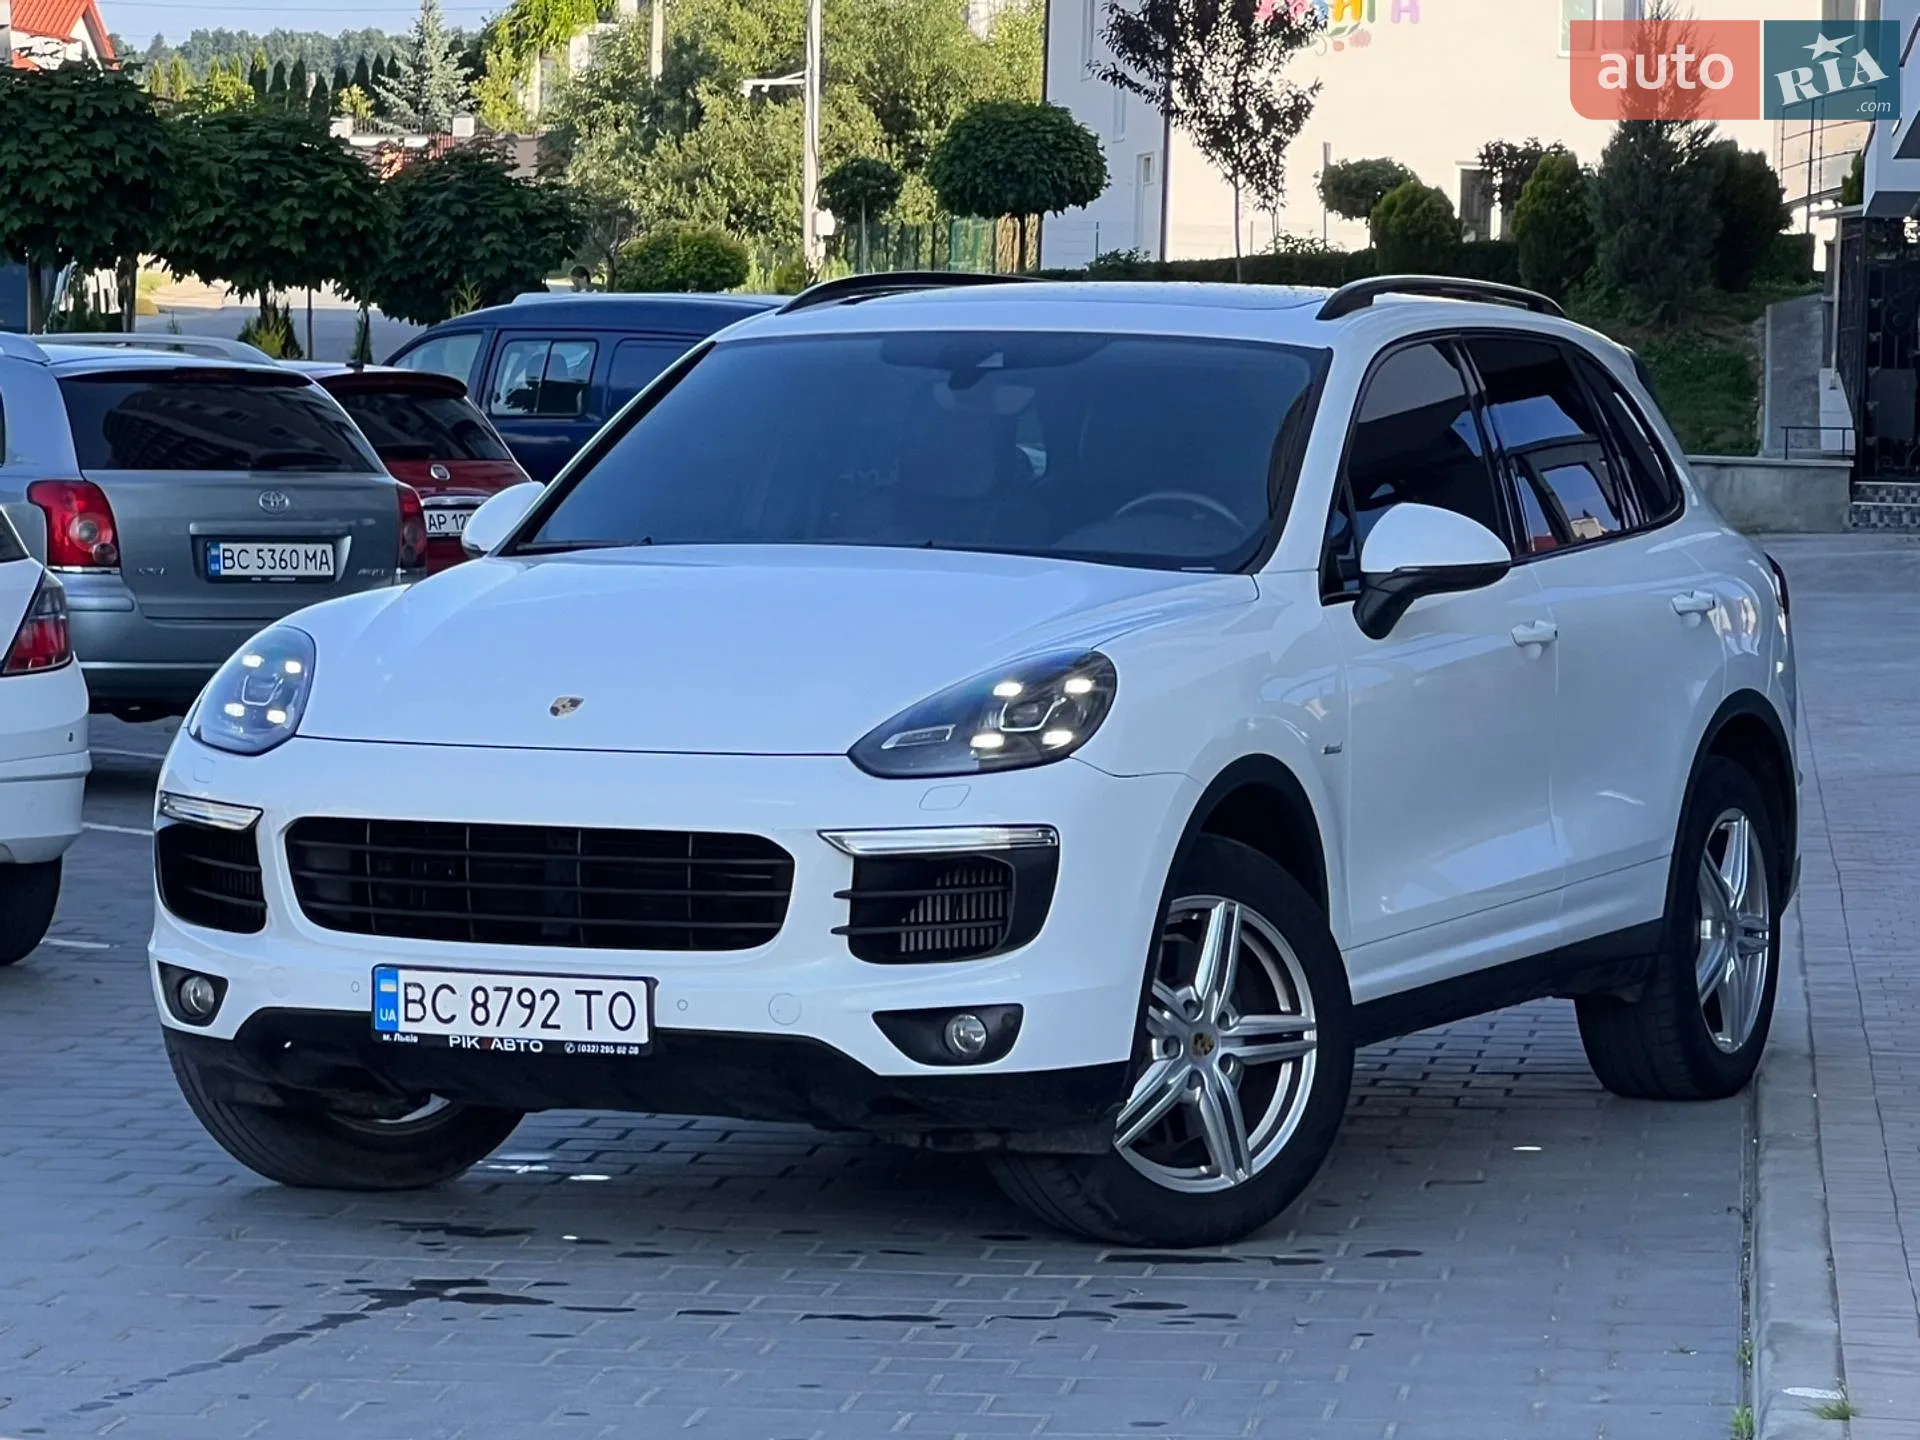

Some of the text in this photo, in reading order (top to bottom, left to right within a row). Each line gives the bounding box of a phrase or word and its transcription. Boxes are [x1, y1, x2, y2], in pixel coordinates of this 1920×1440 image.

[428, 513, 448, 531] AP
[222, 548, 331, 571] BC 5360 MA
[379, 1008, 397, 1022] UA
[404, 982, 636, 1032] BC 8792 TO
[490, 1038, 543, 1053] АВТО
